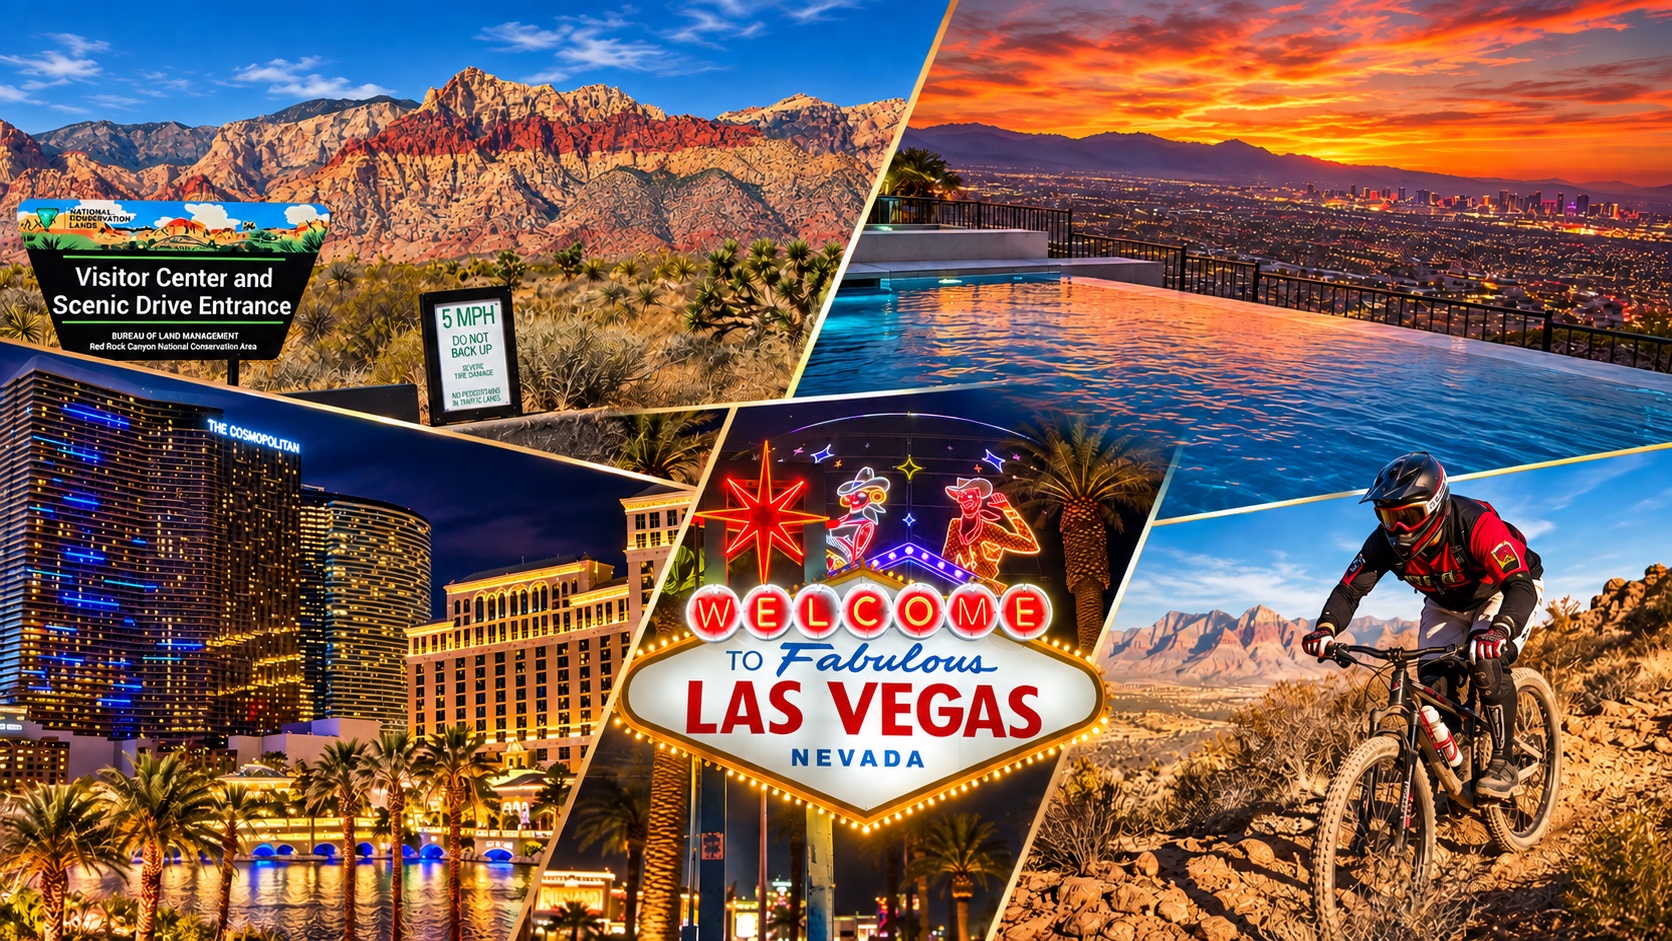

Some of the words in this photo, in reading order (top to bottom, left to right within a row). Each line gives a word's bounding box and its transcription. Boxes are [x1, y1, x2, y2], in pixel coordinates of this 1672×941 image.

[70, 208, 112, 216] NATIONAL
[75, 267, 150, 287] Visitor
[156, 268, 227, 288] Center
[233, 268, 273, 288] and
[52, 294, 130, 315] Scenic
[136, 295, 192, 315] Drive
[199, 296, 292, 316] Entrance
[442, 308, 453, 329] 5
[457, 305, 495, 327] MPH
[111, 332, 145, 340] BUREAU
[146, 332, 157, 340] OF
[158, 332, 181, 340] LAND
[182, 332, 239, 340] MANAGEMENT
[452, 335, 468, 346] DO
[469, 332, 489, 344] NOT
[89, 342, 104, 350] Red
[106, 342, 126, 350] Rock
[127, 342, 156, 352] Canyon
[157, 342, 189, 350] National
[190, 342, 238, 350] Conservation
[239, 342, 257, 350] Area
[451, 346, 477, 359] BACK
[479, 344, 493, 356] UP
[207, 418, 228, 436] THE
[229, 424, 301, 454] COSMOPOLITAN
[698, 596, 1036, 629] WELCOME
[725, 649, 763, 671] TO
[777, 642, 999, 677] Fabulous
[685, 680, 804, 736] LAS
[827, 681, 1043, 739] VEGAS
[791, 748, 925, 769] NEVADA
